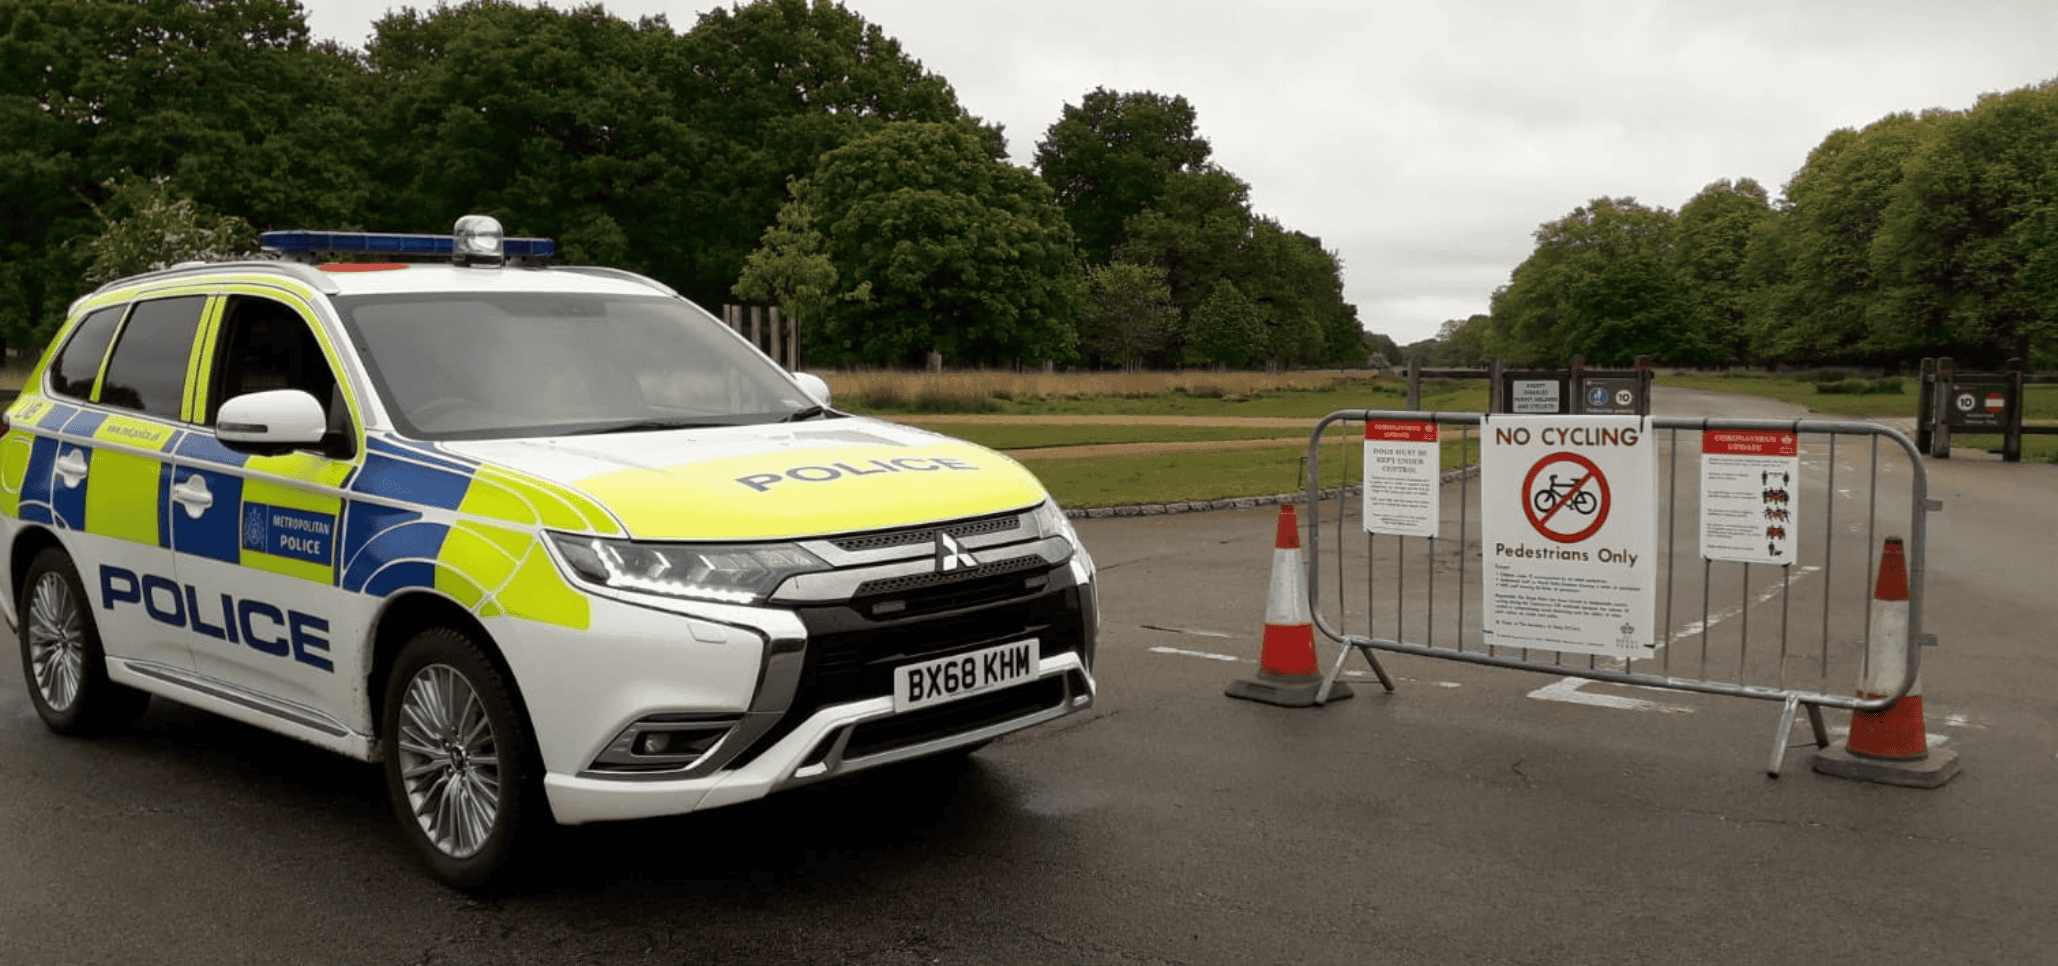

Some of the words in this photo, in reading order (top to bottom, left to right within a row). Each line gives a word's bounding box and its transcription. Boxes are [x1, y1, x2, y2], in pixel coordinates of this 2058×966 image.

[1618, 393, 1629, 402] 10
[1961, 398, 1973, 408] 10
[1496, 427, 1531, 446] NO
[1541, 427, 1639, 447] CYCLING
[734, 457, 980, 493] POLICE
[272, 514, 330, 536] METROPOLITAN
[280, 534, 321, 555] POLICE
[1495, 542, 1590, 562] Pedestrians
[1597, 547, 1639, 569] Only
[99, 563, 335, 674] POLICE
[908, 657, 976, 702] BX68
[983, 644, 1030, 685] KHM
